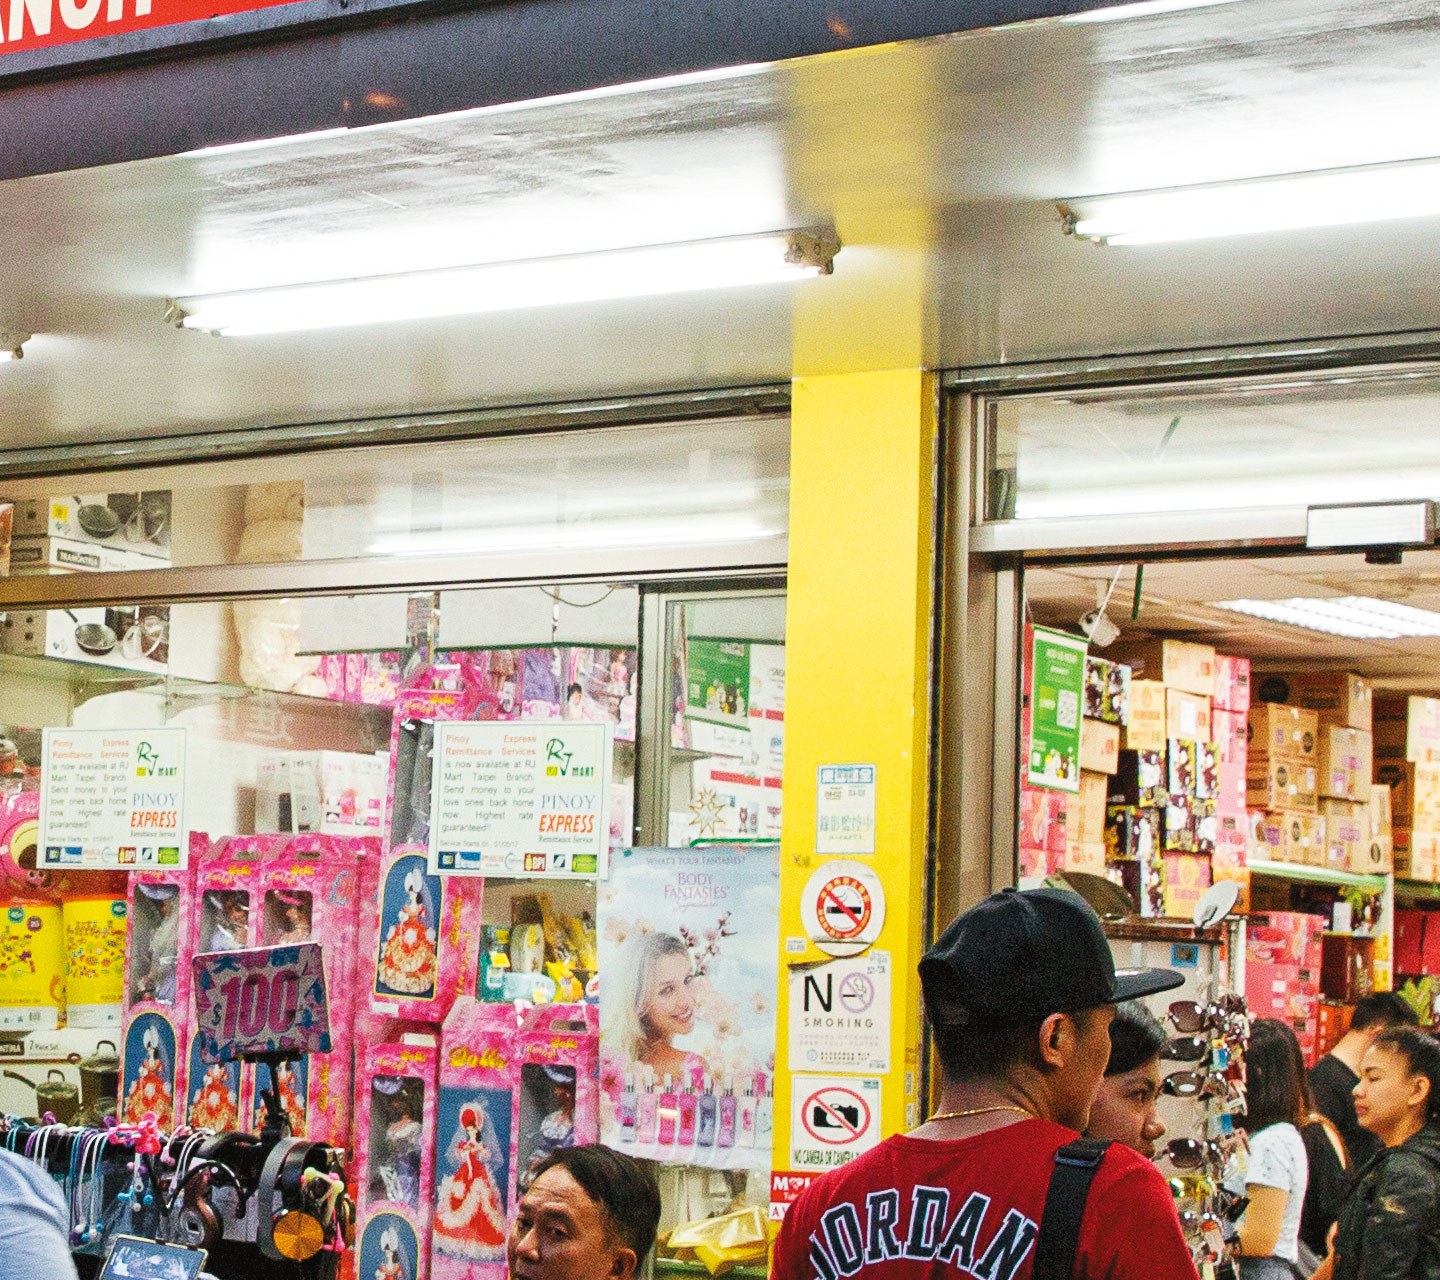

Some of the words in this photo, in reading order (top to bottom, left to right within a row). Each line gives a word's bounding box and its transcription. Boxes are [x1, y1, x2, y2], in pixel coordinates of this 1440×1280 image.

[132, 793, 178, 807] PINOY
[541, 794, 596, 809] PINOY
[130, 811, 177, 828] EXPRESS
[539, 814, 595, 833] EXPRESS
[678, 873, 713, 886] BODY
[664, 885, 728, 899] FANTASIES
[803, 1017, 874, 1028] SMOKING
